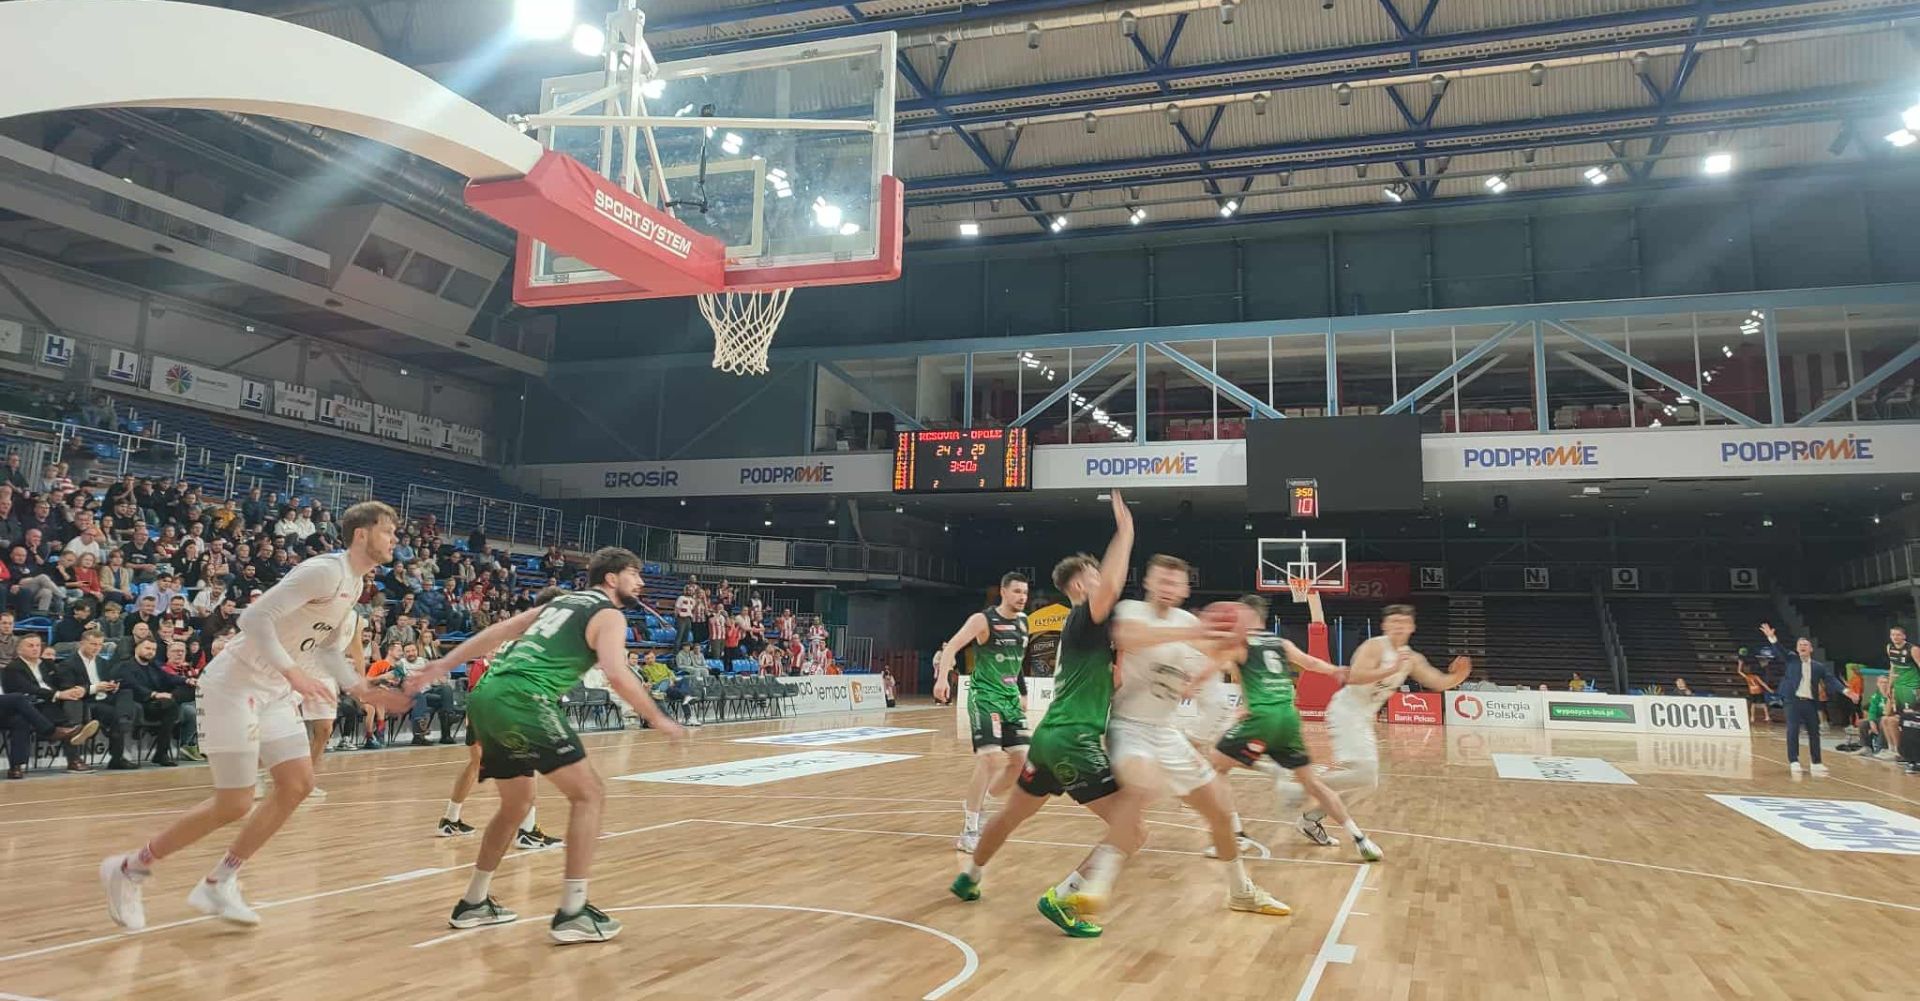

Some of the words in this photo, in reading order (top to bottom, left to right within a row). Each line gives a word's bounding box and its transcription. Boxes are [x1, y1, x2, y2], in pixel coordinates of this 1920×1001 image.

[1298, 498, 1313, 514] 10
[1486, 700, 1530, 712] Energia
[1486, 710, 1525, 720] Polska
